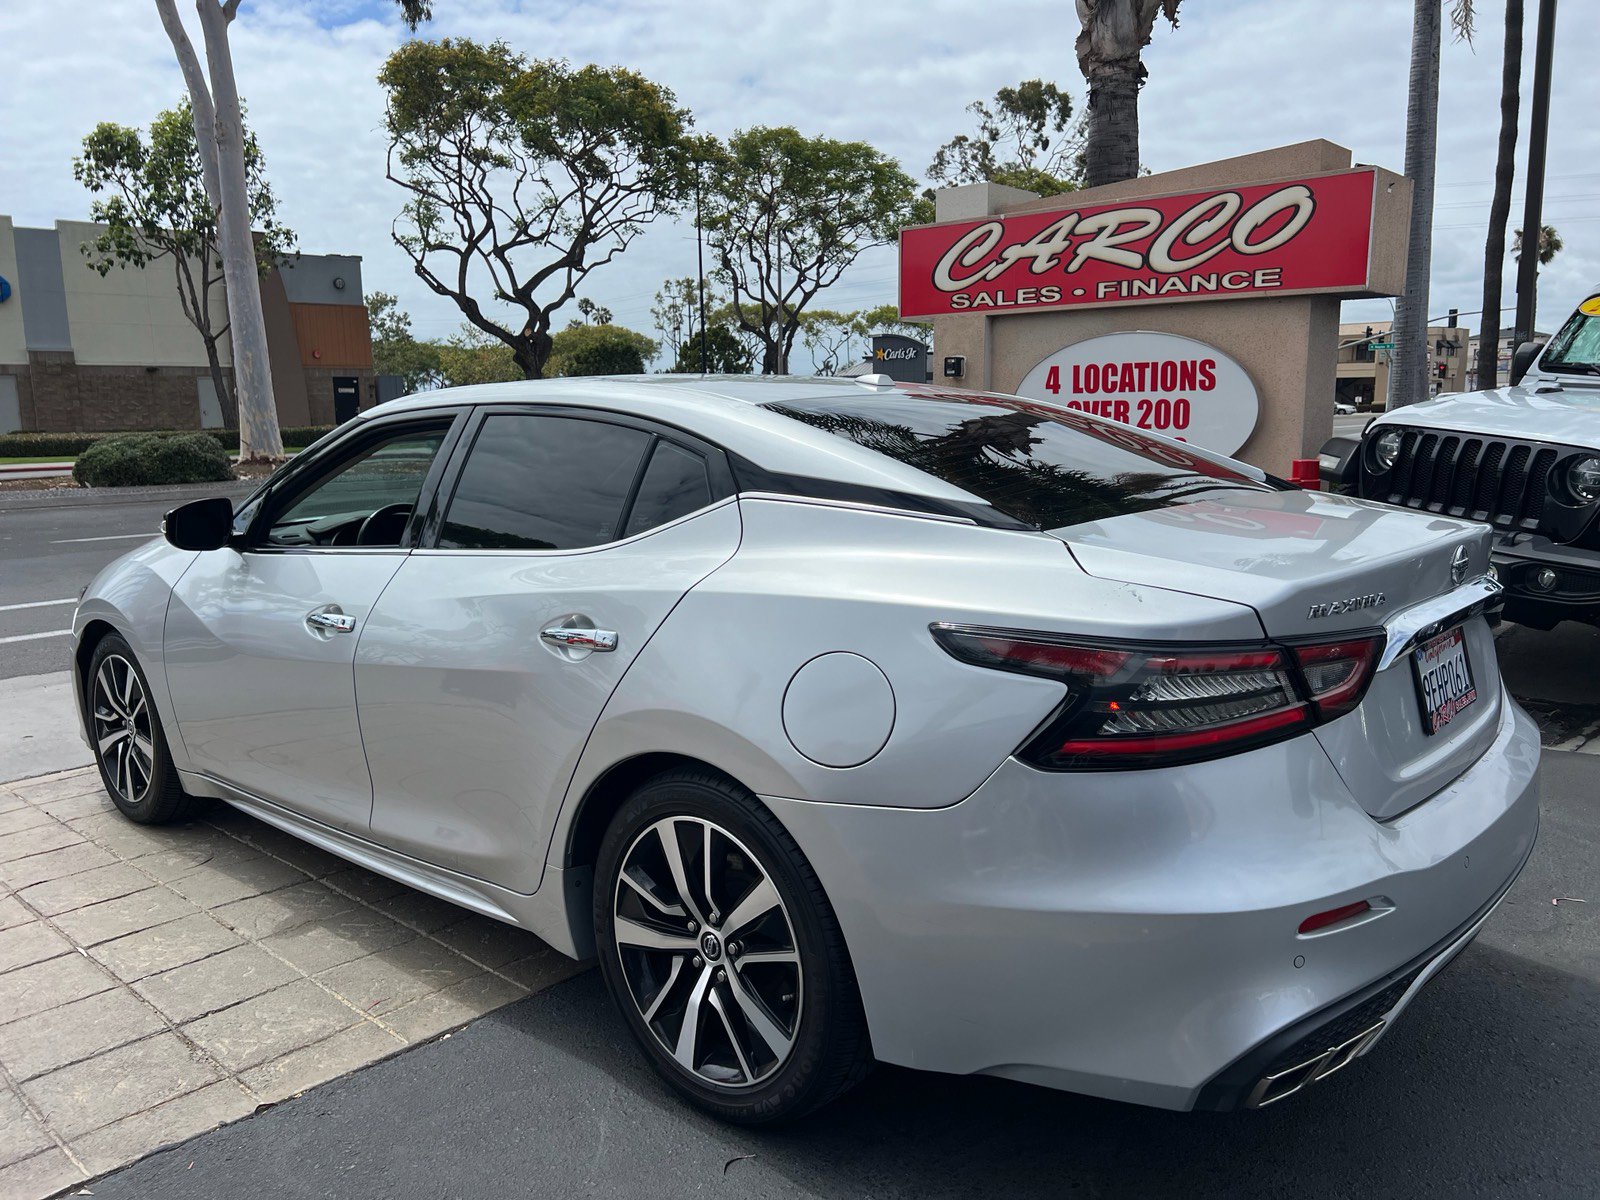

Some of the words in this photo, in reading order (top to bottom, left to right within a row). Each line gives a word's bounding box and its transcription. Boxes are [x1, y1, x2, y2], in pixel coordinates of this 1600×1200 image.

[932, 184, 1316, 292] CARCO
[950, 286, 1062, 309] SALES
[1096, 268, 1283, 300] FINANCE
[1045, 365, 1061, 395] 4
[1072, 359, 1217, 394] LOCATIONS
[1136, 398, 1191, 430] 200
[1308, 592, 1385, 619] MAXIMA
